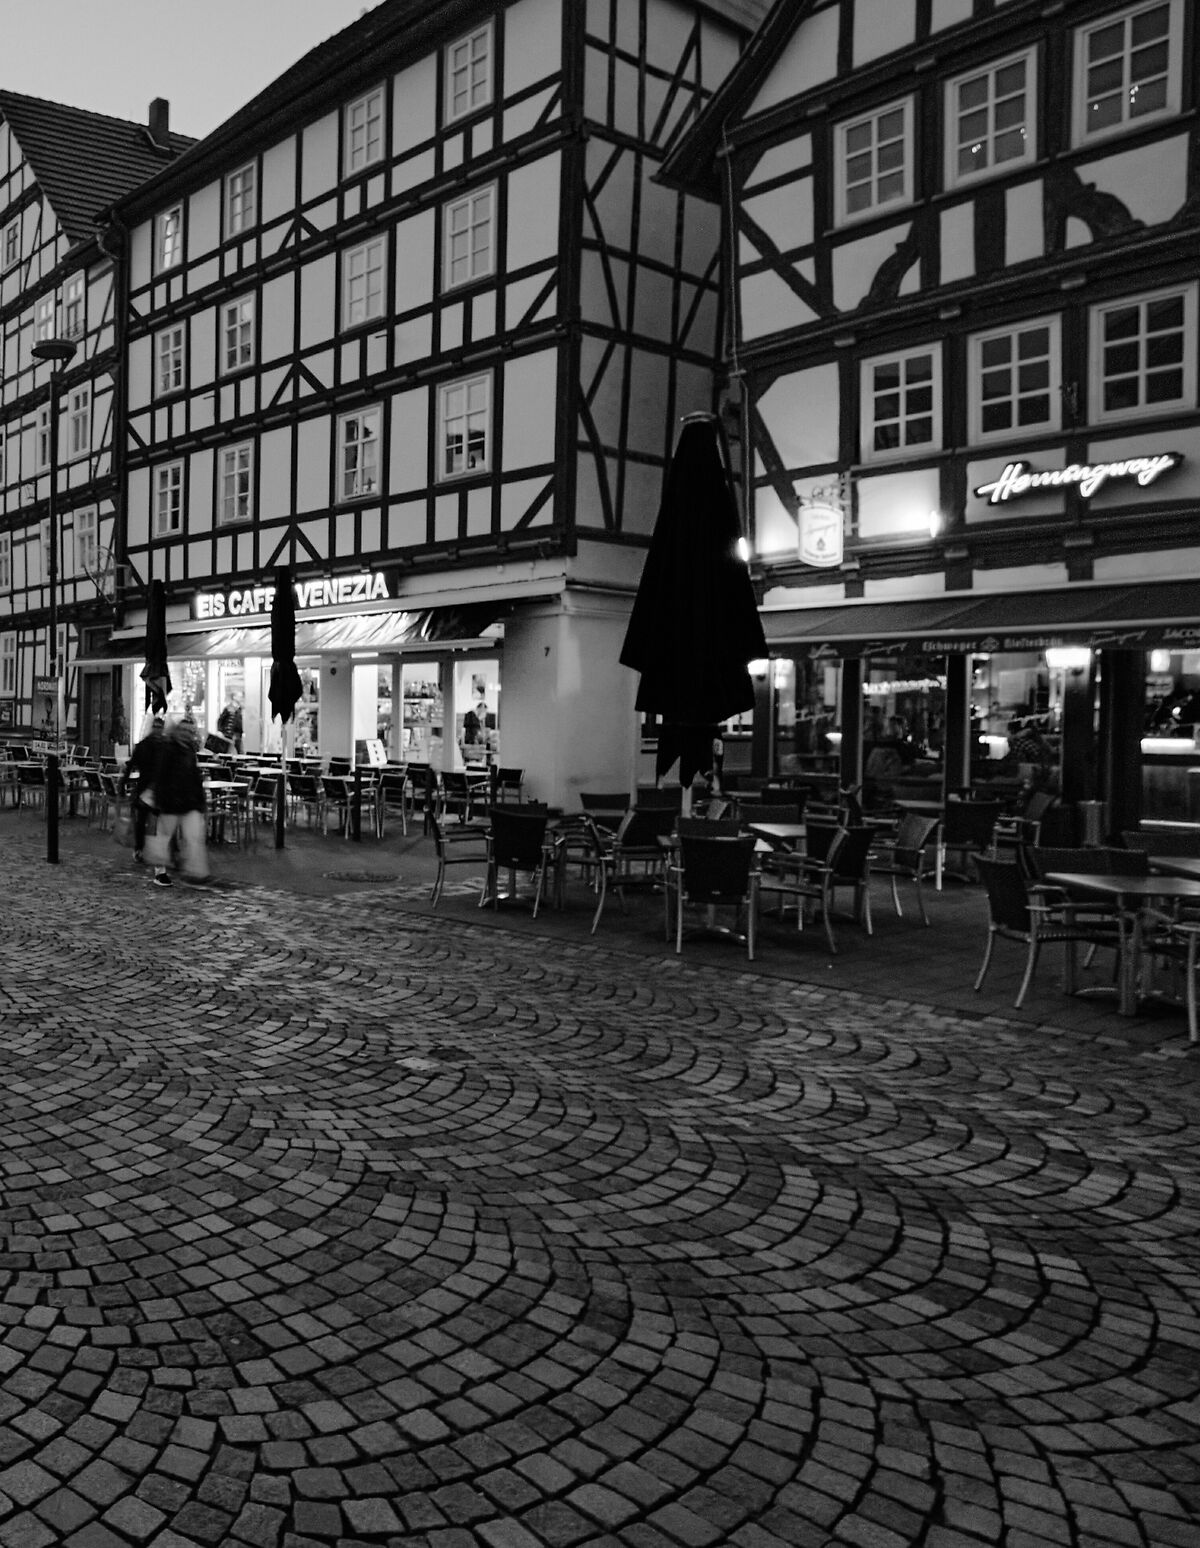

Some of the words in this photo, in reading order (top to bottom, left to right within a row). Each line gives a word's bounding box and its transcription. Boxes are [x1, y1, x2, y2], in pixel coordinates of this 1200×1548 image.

[975, 454, 1178, 503] Hemingway
[196, 592, 226, 619] EIS
[294, 571, 390, 609] VENEZIA
